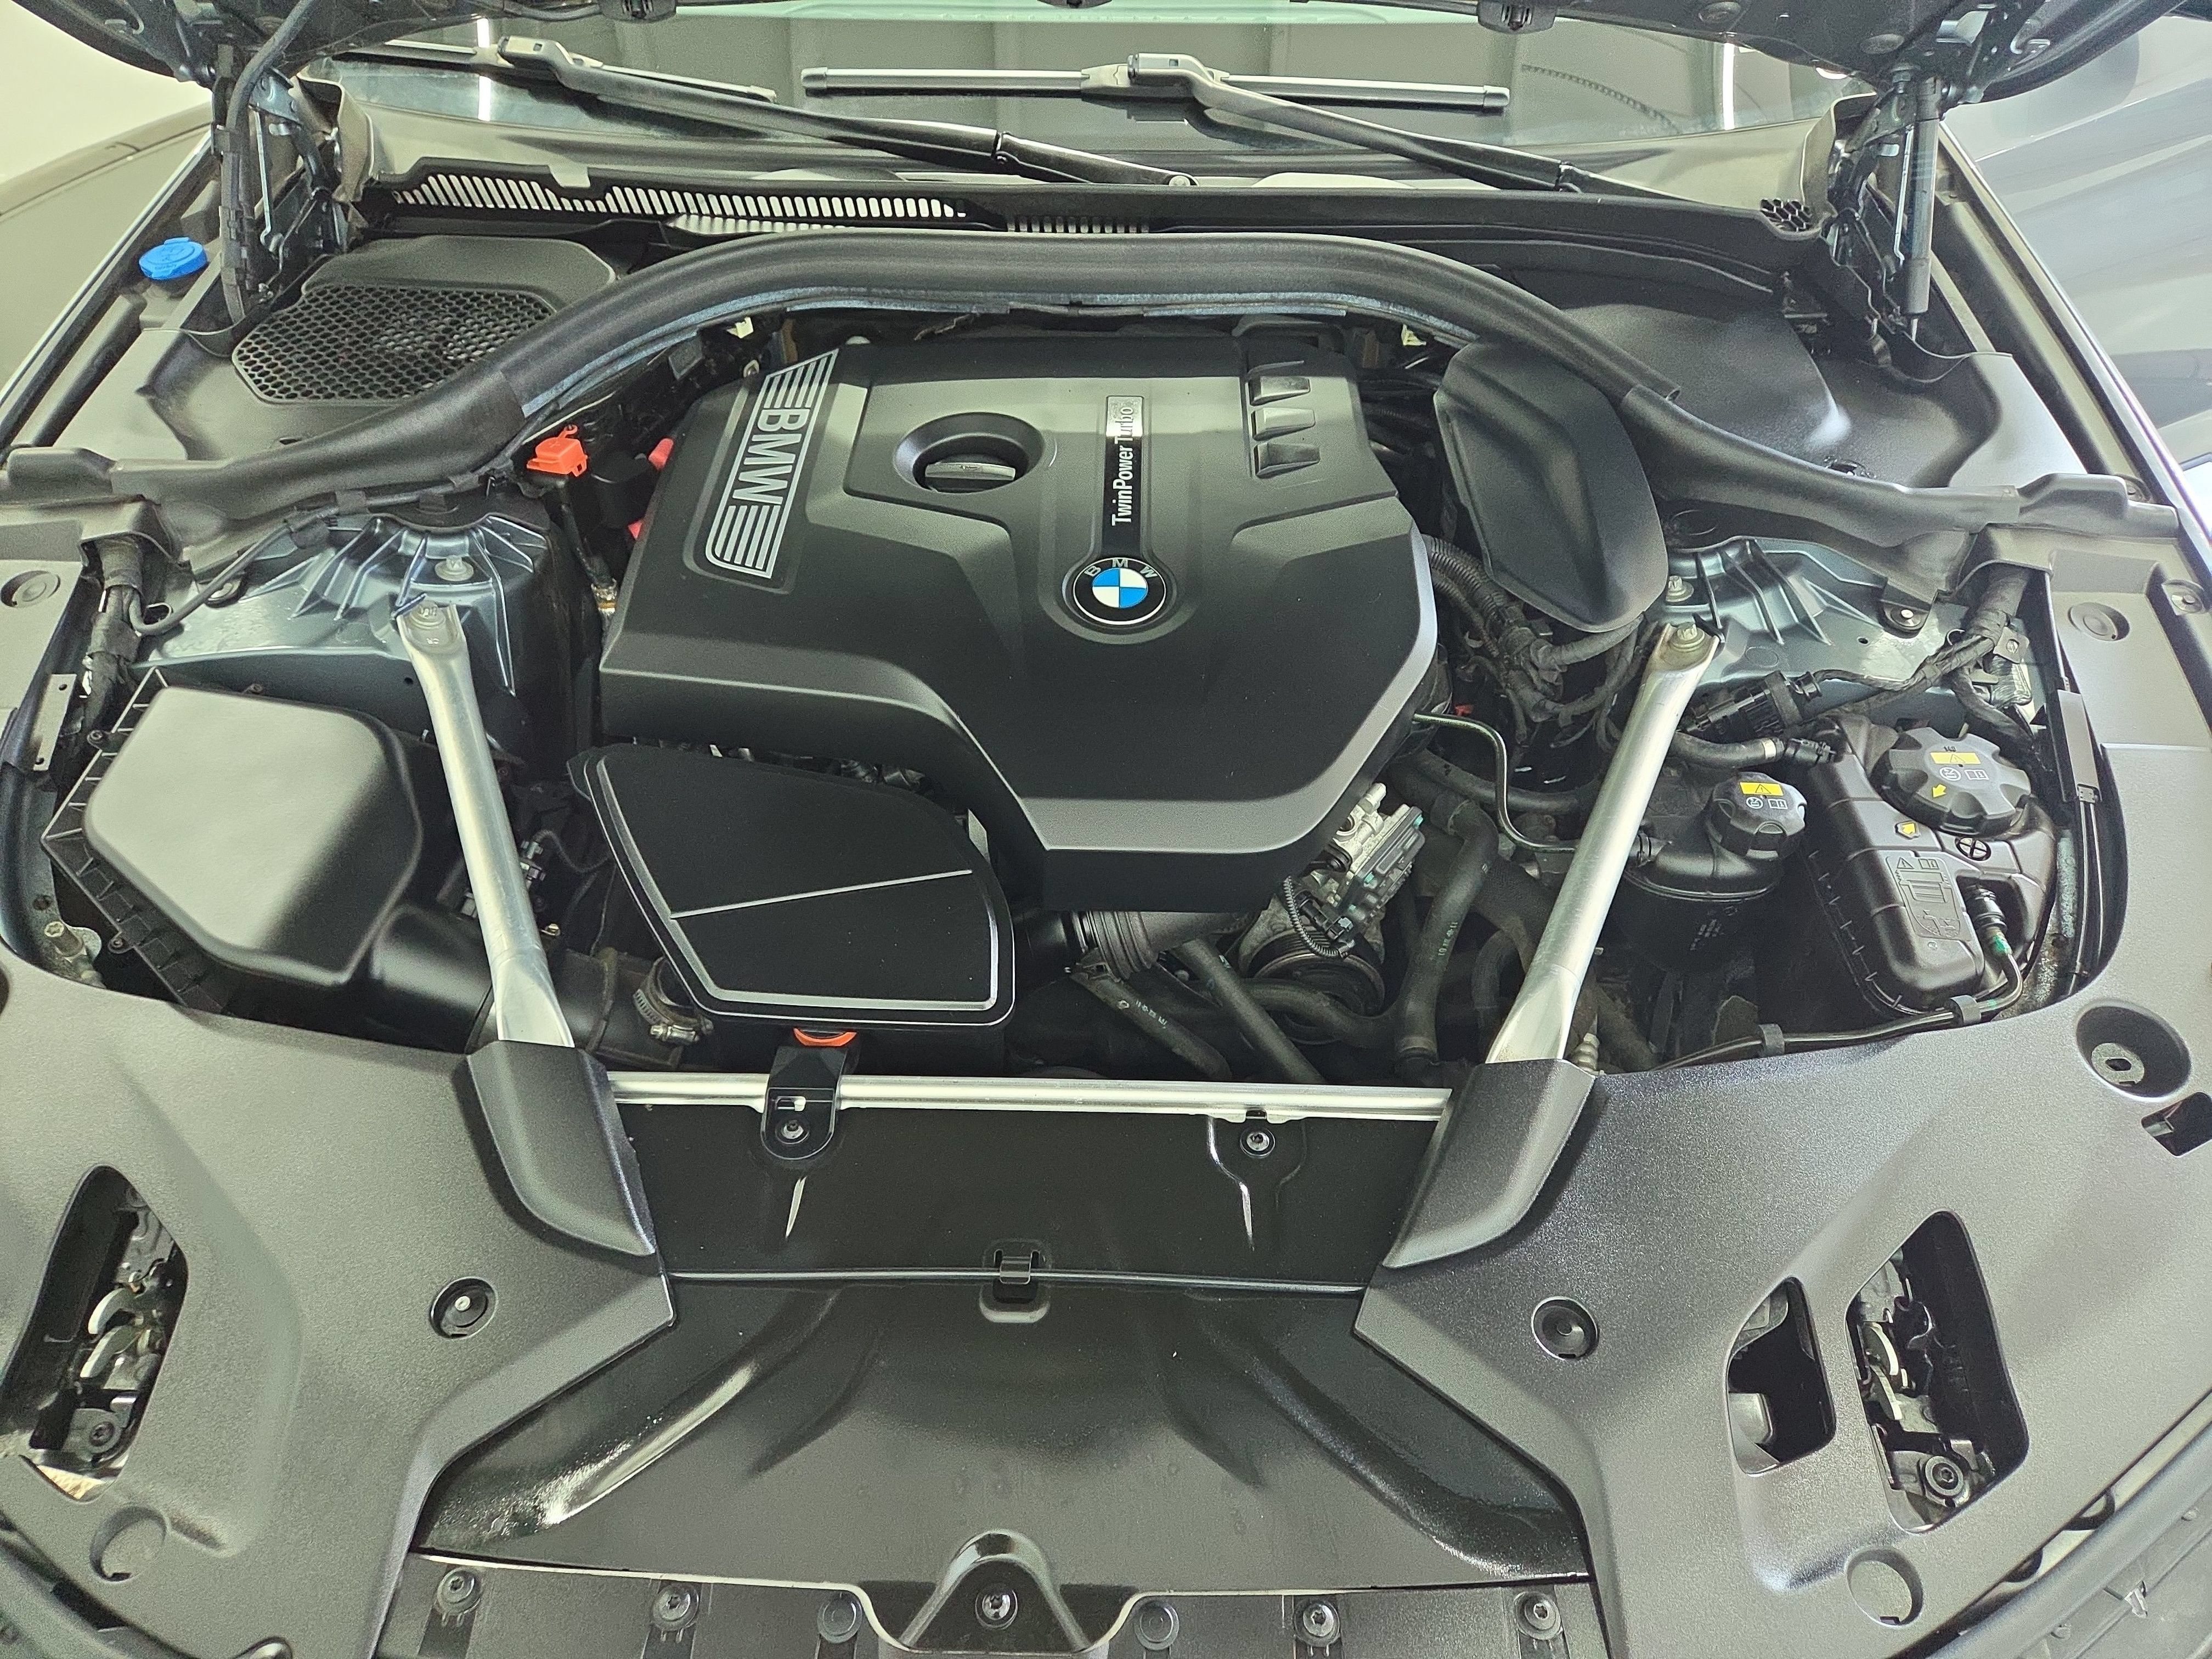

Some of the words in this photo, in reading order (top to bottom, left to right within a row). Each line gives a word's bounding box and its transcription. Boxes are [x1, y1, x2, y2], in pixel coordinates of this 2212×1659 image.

[1114, 407, 1134, 444] Turbo
[732, 409, 810, 504] BMW
[1111, 446, 1133, 526] TwinPower
[1084, 558, 1157, 578] BMW
